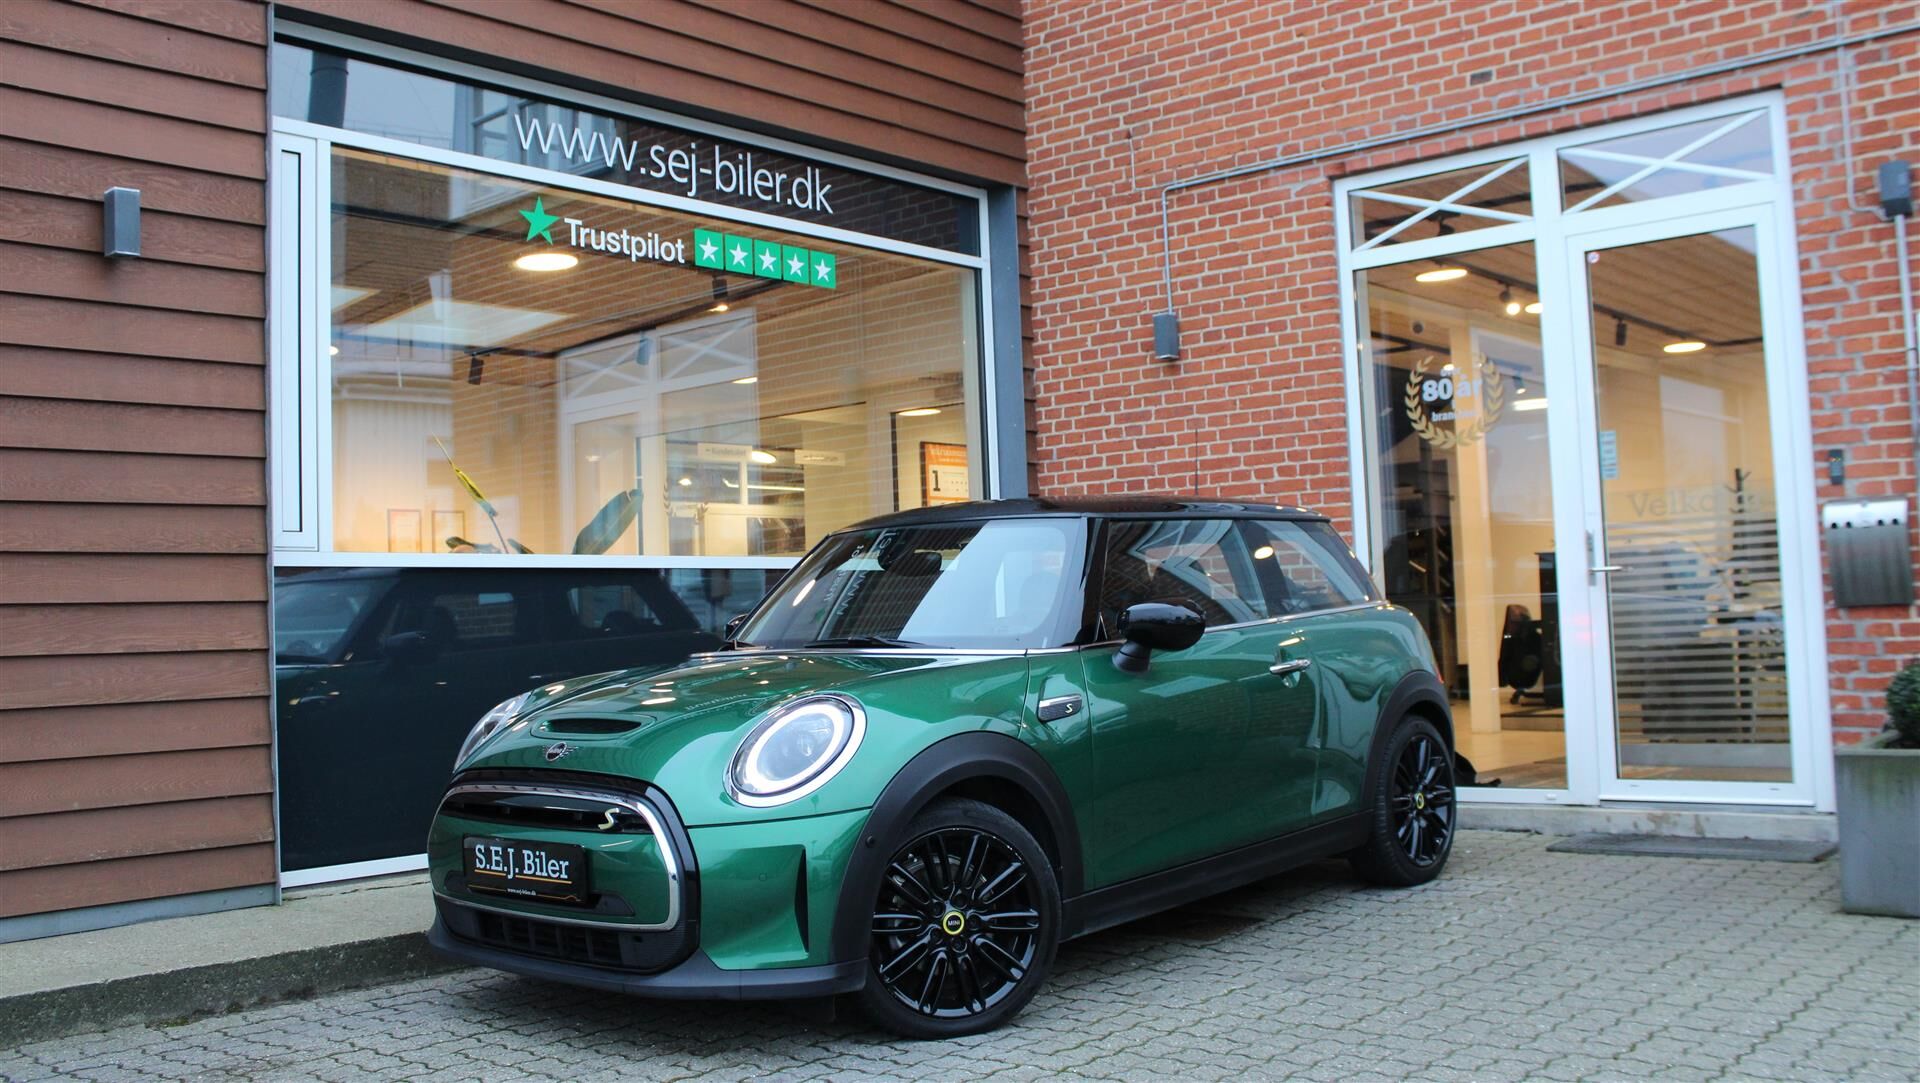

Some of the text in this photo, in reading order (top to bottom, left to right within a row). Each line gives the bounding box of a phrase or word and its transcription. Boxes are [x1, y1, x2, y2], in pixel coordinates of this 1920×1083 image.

[515, 113, 834, 214] www.sej-biler.dk
[564, 217, 686, 263] Trustpilot
[1422, 379, 1453, 401] 80
[1064, 702, 1073, 714] S
[598, 808, 619, 829] S
[474, 843, 569, 880] S.E.J. Biler
